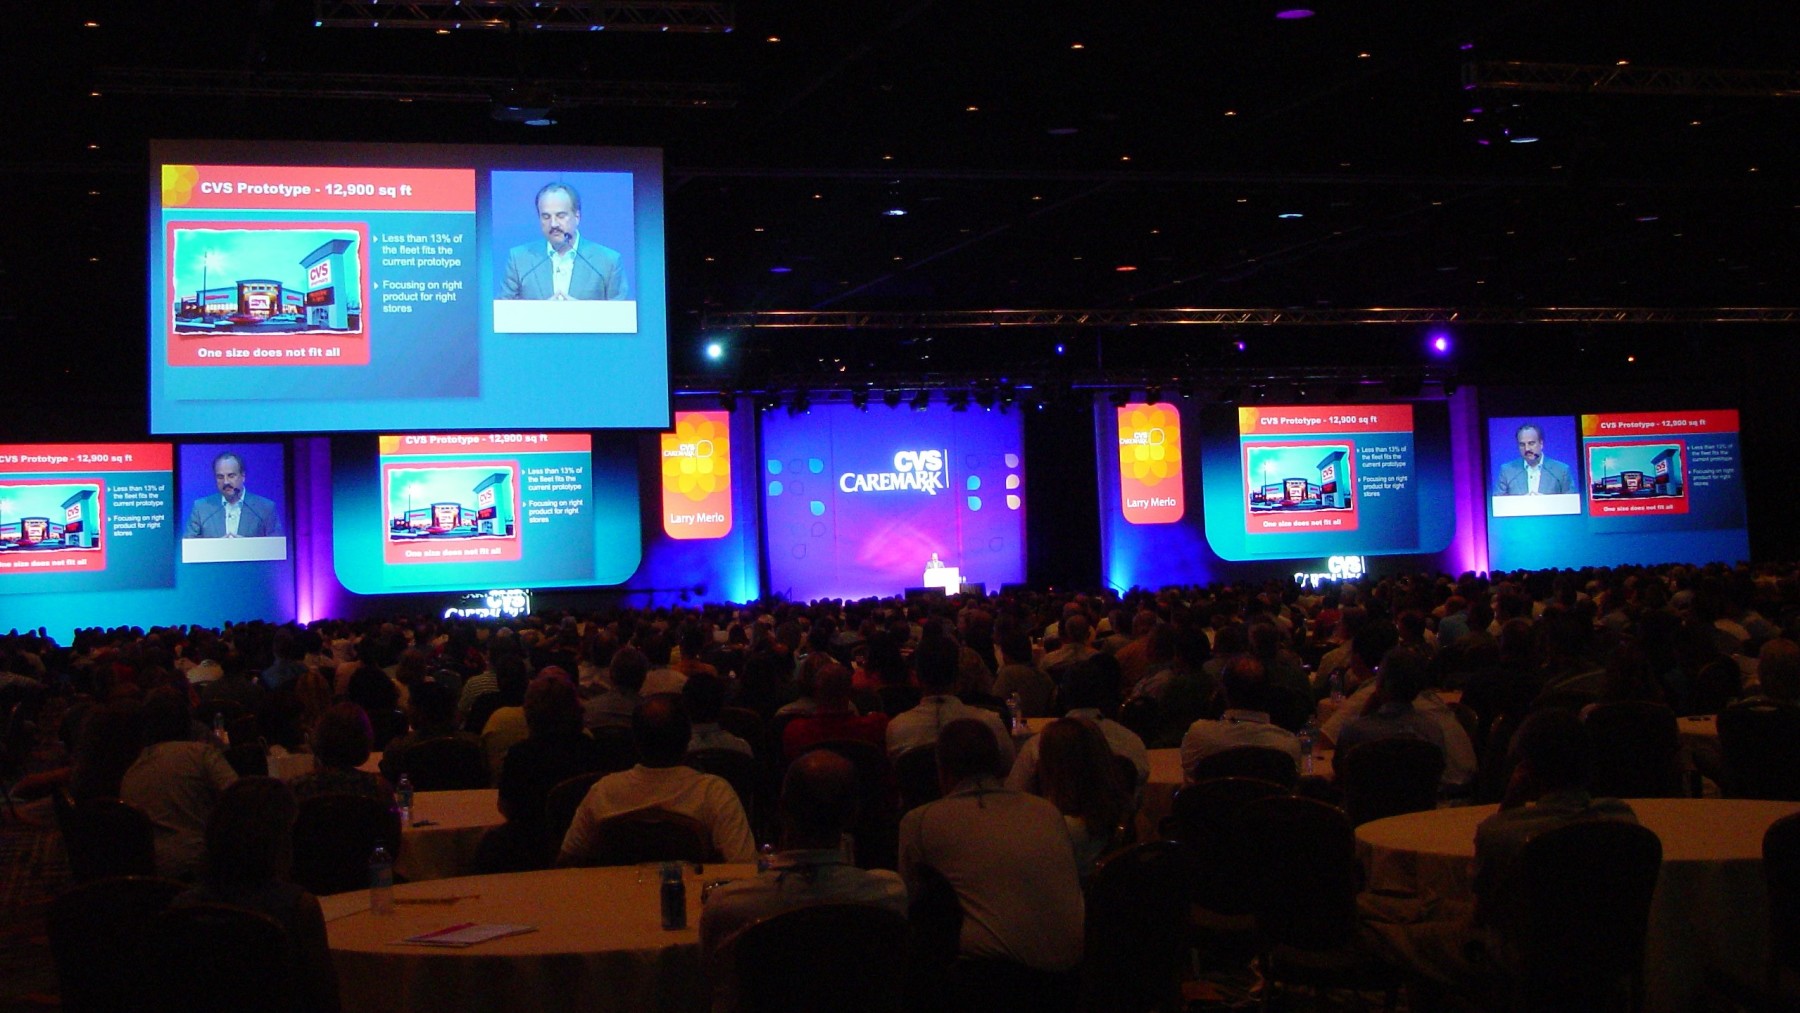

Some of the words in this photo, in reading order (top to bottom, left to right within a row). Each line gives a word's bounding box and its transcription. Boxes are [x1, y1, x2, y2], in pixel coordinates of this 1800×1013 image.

[201, 182, 233, 194] CVS
[237, 183, 311, 197] Prototype
[325, 184, 374, 196] 12,900
[378, 186, 396, 198] sq
[400, 184, 412, 196] ft
[382, 233, 405, 242] Less
[407, 234, 427, 242] than
[430, 234, 450, 243] 13%
[453, 234, 463, 243] of
[382, 245, 397, 254] the
[400, 245, 420, 254] fleet
[422, 245, 436, 254] fits
[438, 246, 453, 255] the
[382, 257, 415, 266] current
[418, 257, 461, 268] prototype
[310, 263, 328, 280] CVS
[383, 280, 425, 291] Focusing
[442, 281, 463, 291] right
[383, 292, 418, 303] product
[420, 292, 433, 301] for
[436, 292, 456, 303] right
[383, 304, 412, 312] stores
[198, 348, 221, 357] One
[226, 348, 250, 357] size
[253, 348, 282, 357] does
[286, 348, 306, 357] not
[309, 347, 323, 357] fit
[326, 347, 340, 357] all
[1260, 417, 1278, 425] CVS
[1280, 417, 1321, 425] Prototype
[1329, 416, 1356, 424] 12,900
[1359, 417, 1369, 425] sq
[406, 436, 427, 444] CVS
[430, 435, 479, 445] Prototype
[489, 434, 522, 444] 12,900
[525, 435, 537, 444] sq
[540, 434, 548, 442] ft
[0, 455, 18, 463] CVS
[21, 455, 68, 464] Prototype
[77, 454, 108, 463] 12,900
[125, 454, 132, 462] ft
[894, 450, 943, 472] CVS
[840, 470, 943, 495] CAREMARK
[1127, 498, 1149, 509] Larry
[670, 514, 694, 525] Larry
